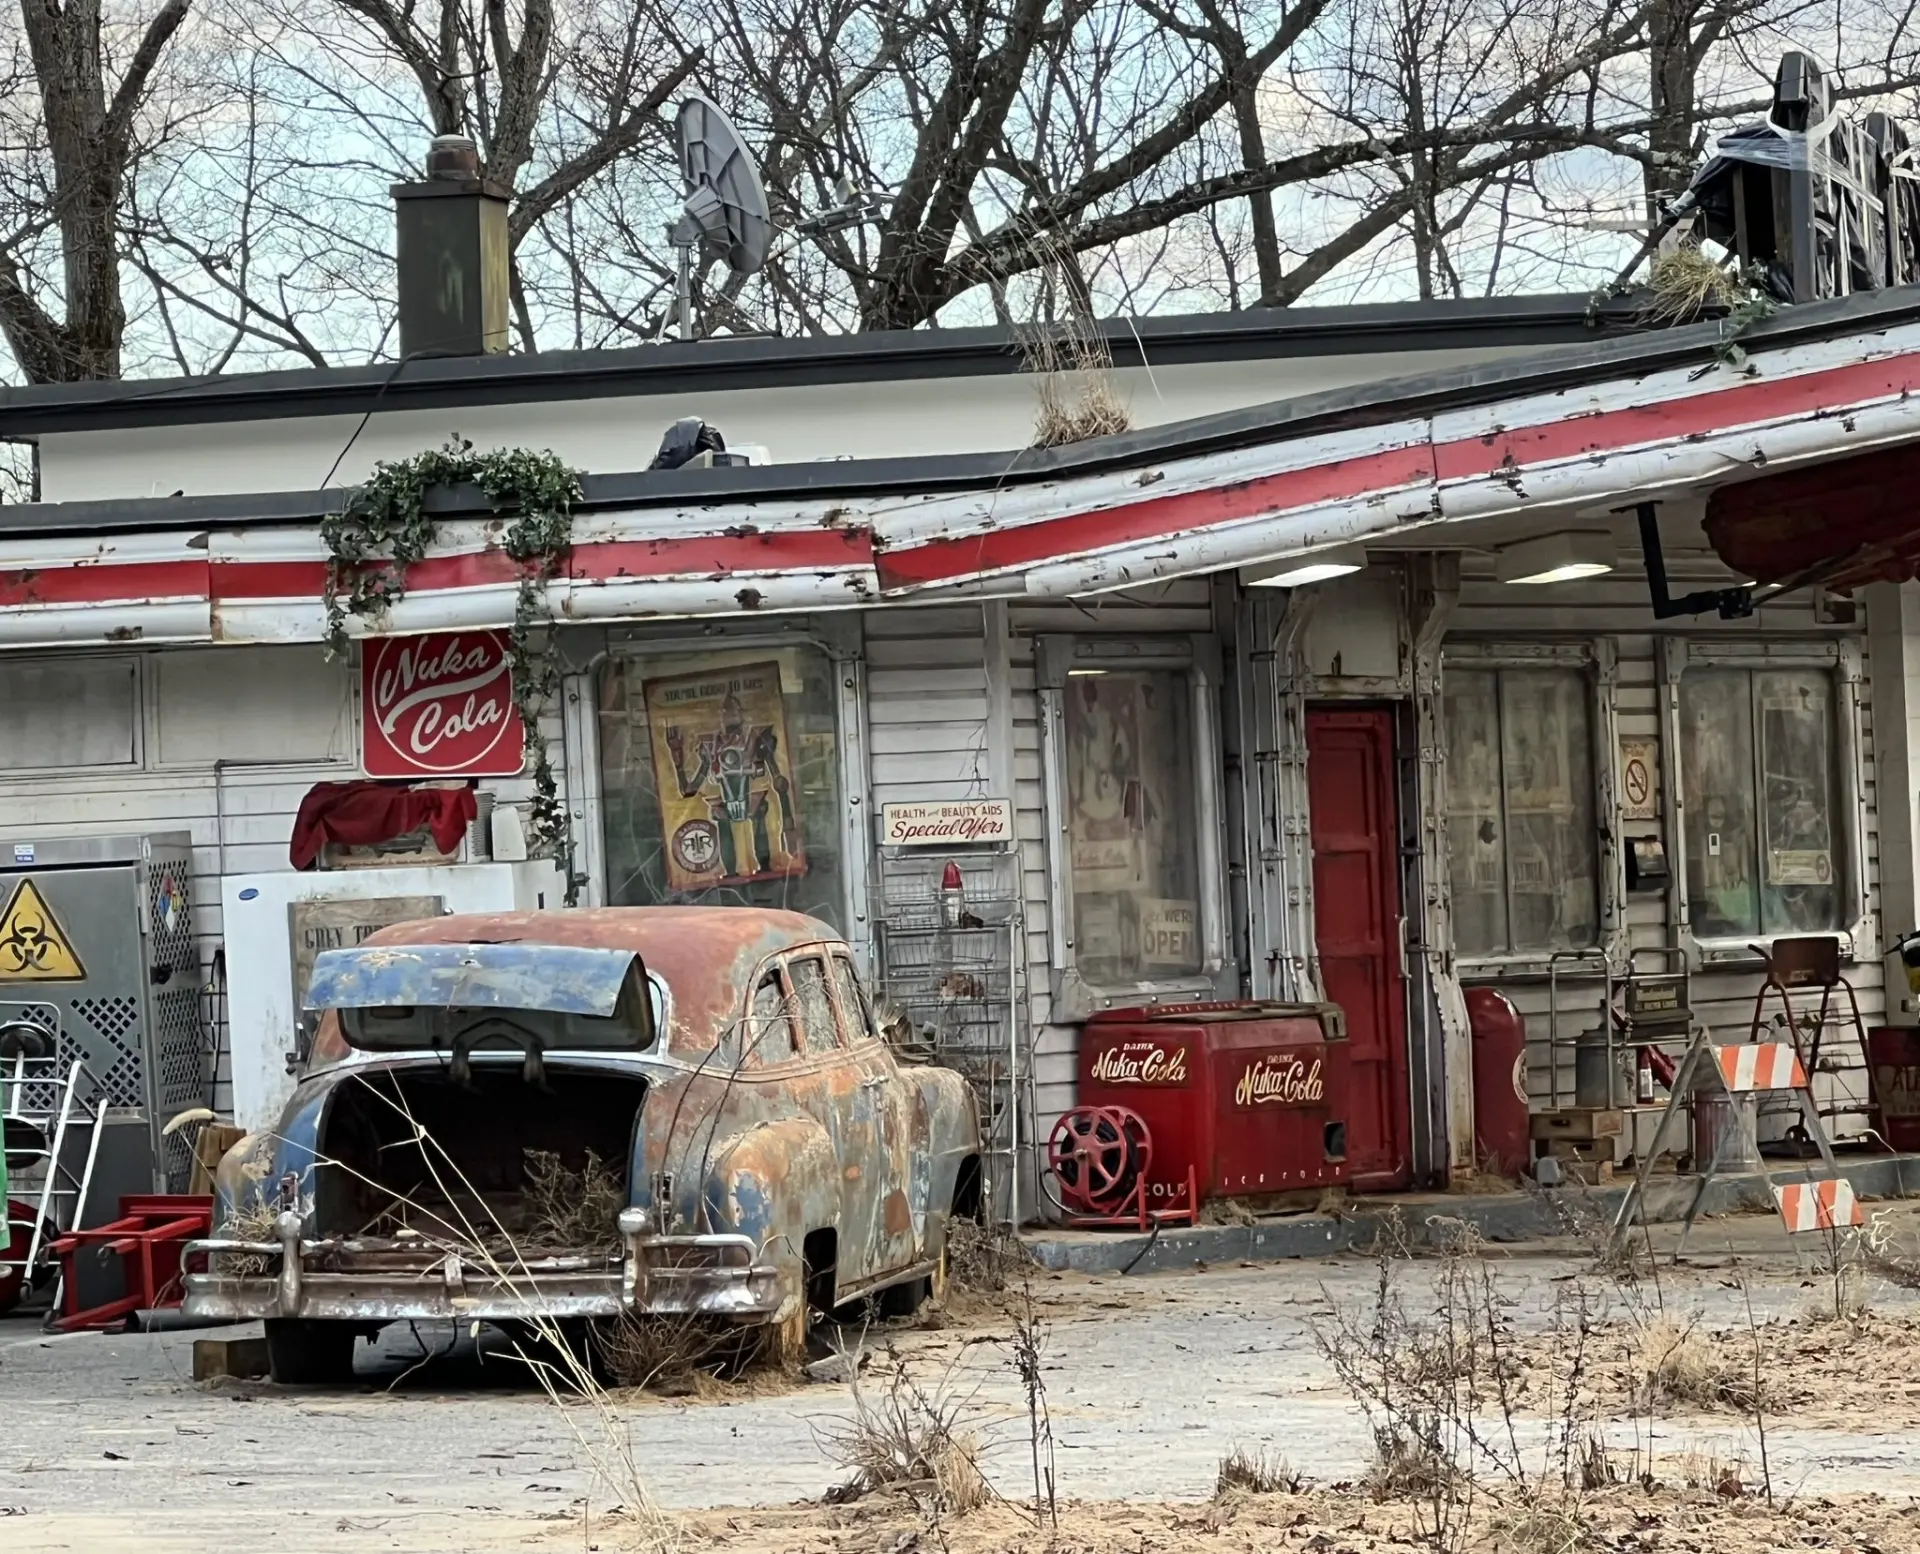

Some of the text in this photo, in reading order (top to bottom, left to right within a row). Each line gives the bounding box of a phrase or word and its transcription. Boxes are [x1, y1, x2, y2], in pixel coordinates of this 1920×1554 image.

[379, 635, 490, 707] Nuka
[410, 693, 503, 754] Cola
[890, 808, 926, 819] HEALTH
[941, 806, 978, 817] BEAUTY
[981, 805, 1003, 816] AIDS
[890, 817, 1004, 842] Special Offers
[1143, 929, 1194, 957] OPEN
